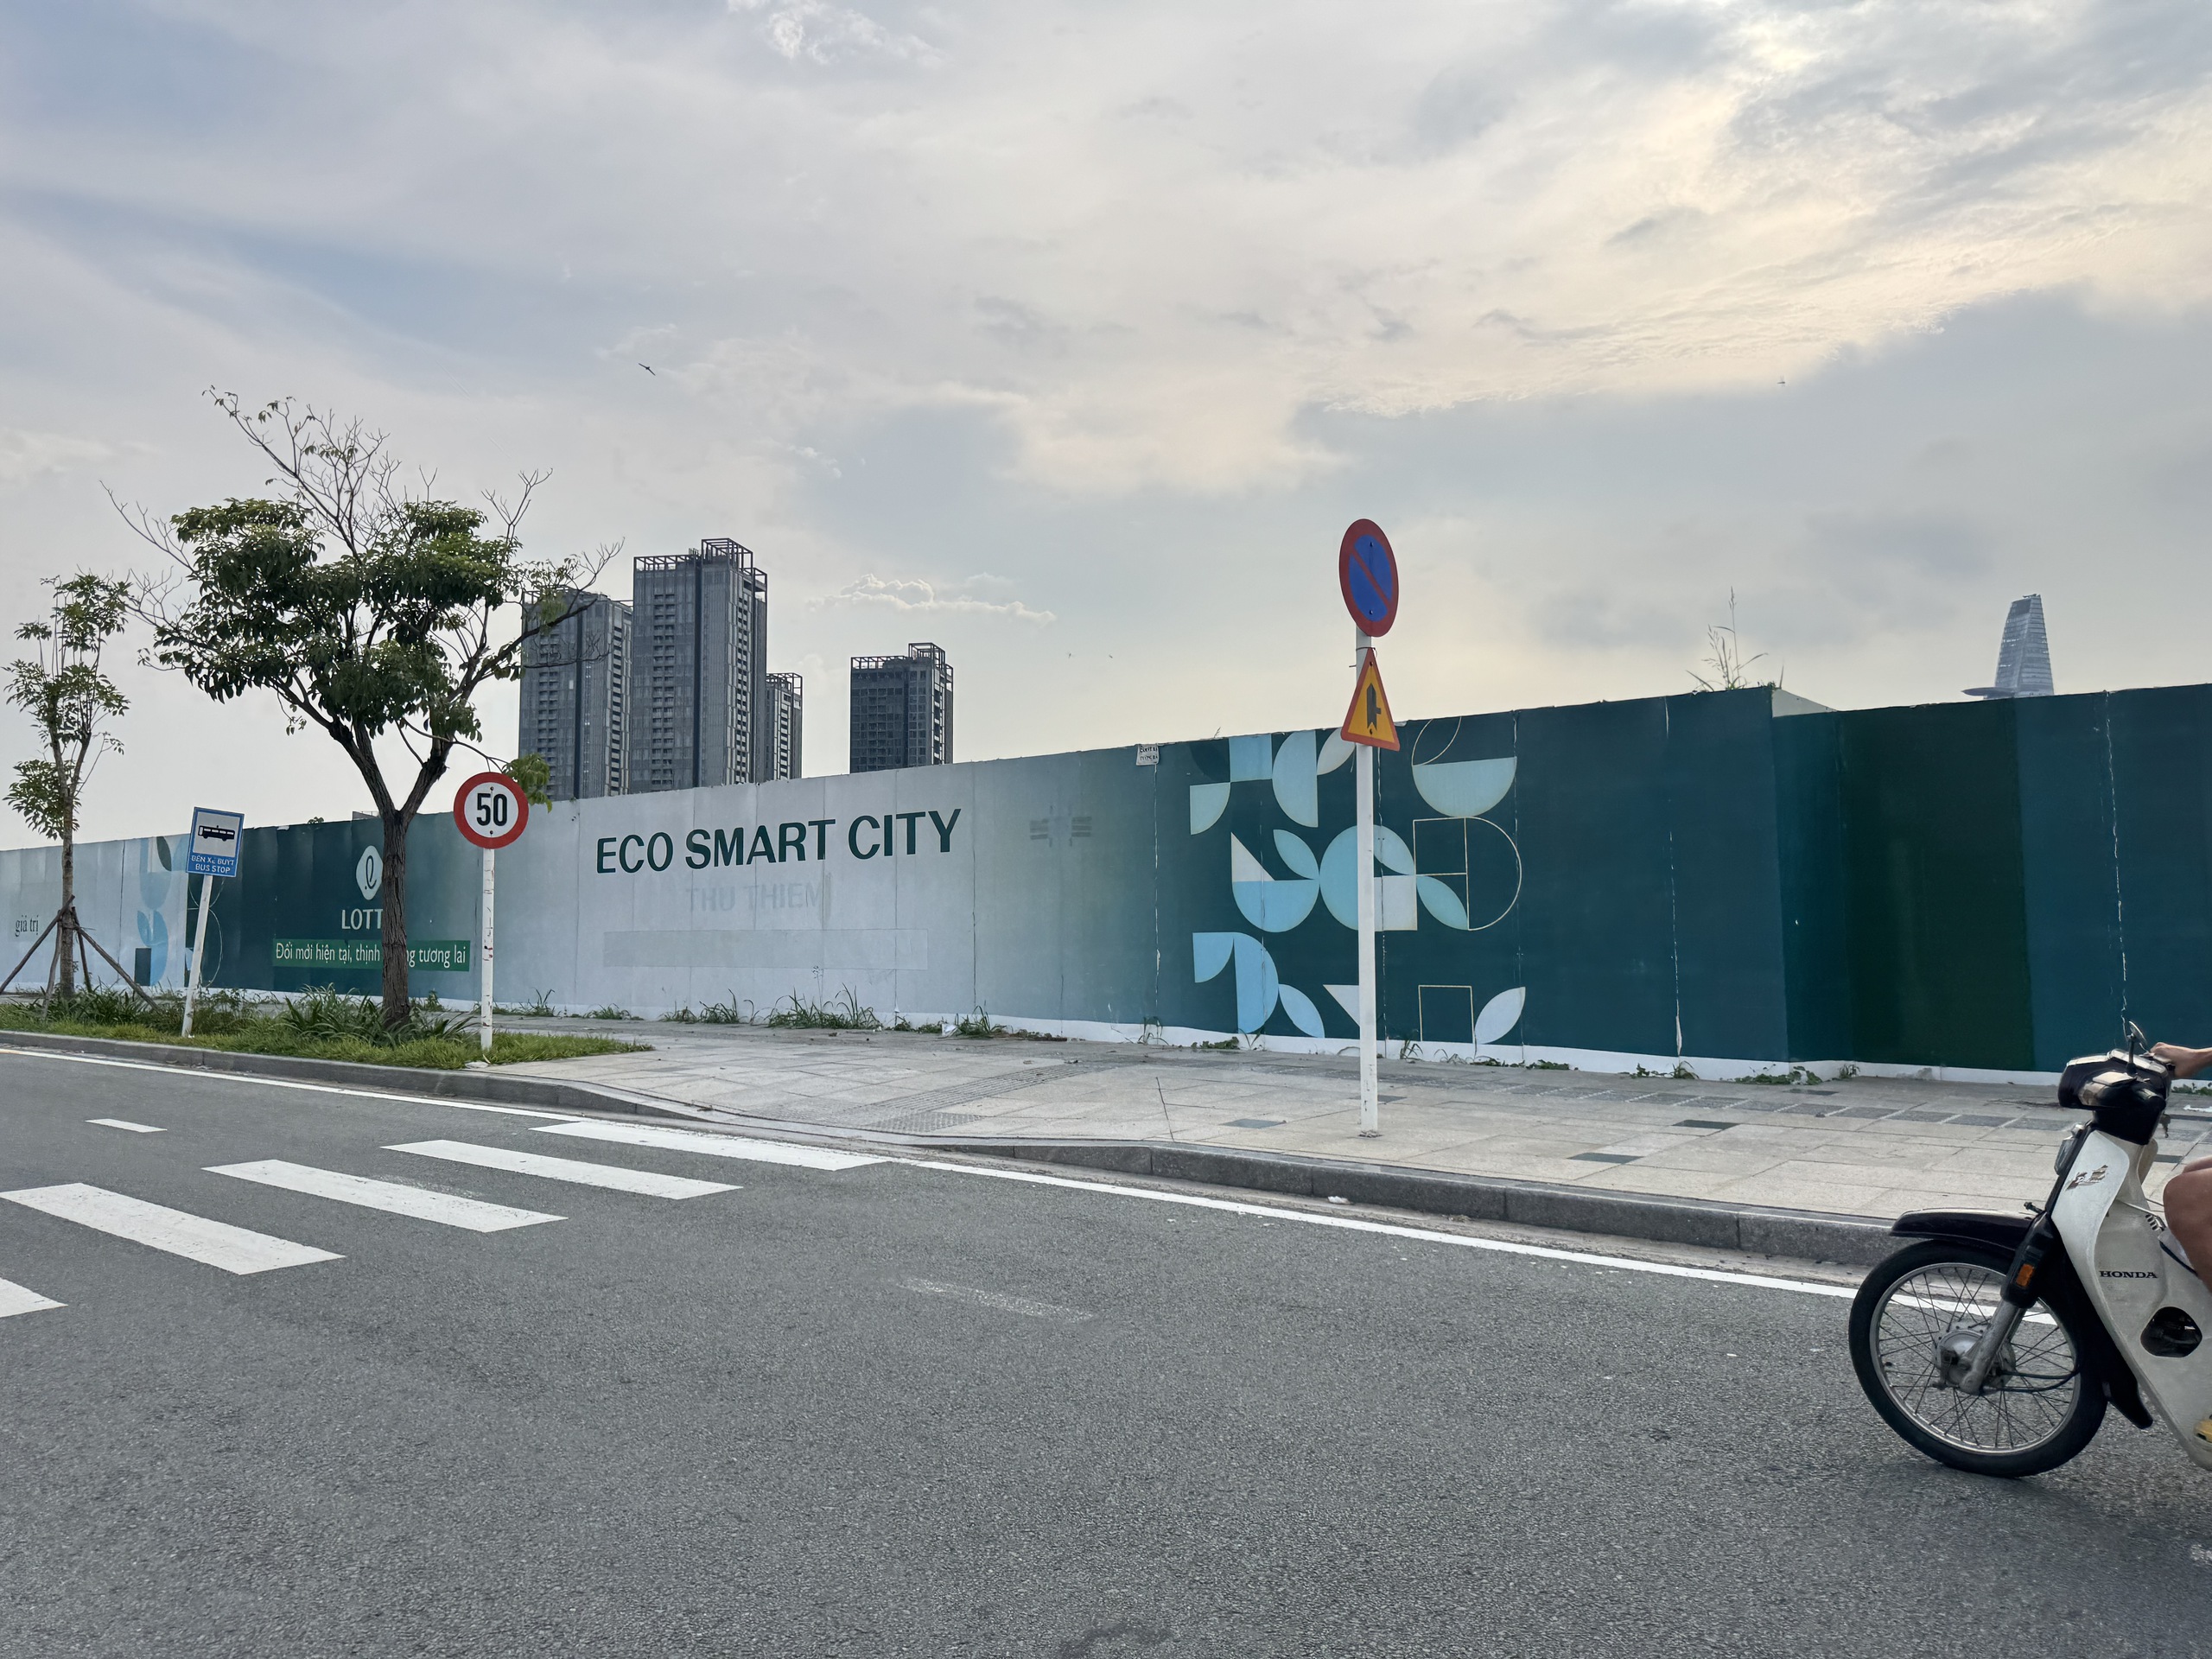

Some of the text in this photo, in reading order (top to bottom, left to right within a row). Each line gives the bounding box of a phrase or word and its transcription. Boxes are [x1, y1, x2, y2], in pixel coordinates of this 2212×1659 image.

[476, 792, 508, 826] 50
[597, 808, 962, 874] ECO SMART CITY
[195, 863, 231, 874] BUS STOP
[341, 908, 384, 930] LOTT
[276, 941, 293, 960] Đổi
[296, 944, 313, 960] mới
[315, 943, 335, 963] hiện
[355, 943, 380, 964] thịnh
[418, 948, 450, 968] tương
[454, 944, 466, 963] lai
[2099, 1270, 2158, 1279] HONDA
